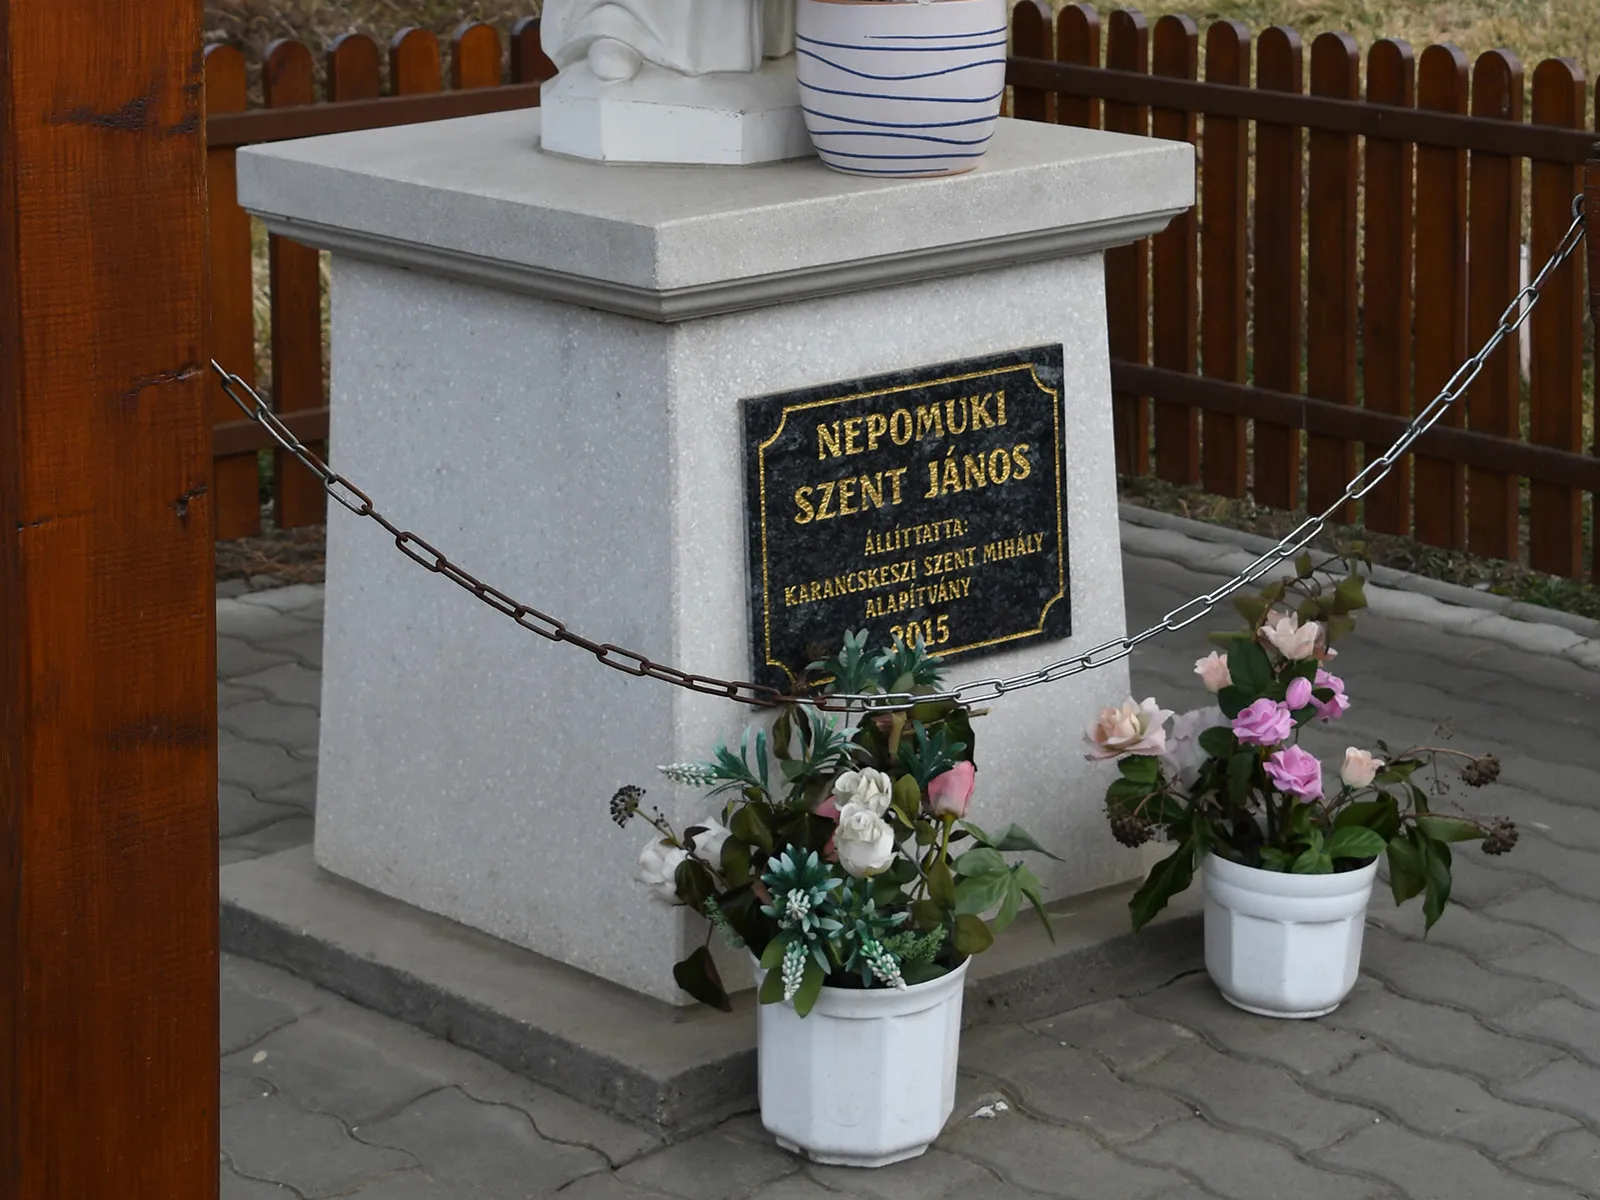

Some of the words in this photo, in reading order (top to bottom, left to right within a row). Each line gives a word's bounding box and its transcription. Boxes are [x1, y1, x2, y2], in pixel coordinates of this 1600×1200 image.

[816, 390, 1008, 461] NEPOMUKI
[793, 467, 907, 524] SZENT
[924, 443, 1032, 499] JÁNOS
[784, 559, 917, 607] KARANCSKESZI
[924, 546, 977, 577] SZENT
[983, 530, 1045, 565] MIHÁLY
[864, 517, 969, 556] ÁLLÍTTATTA:
[865, 576, 971, 619] ALAPÍTVÁNY
